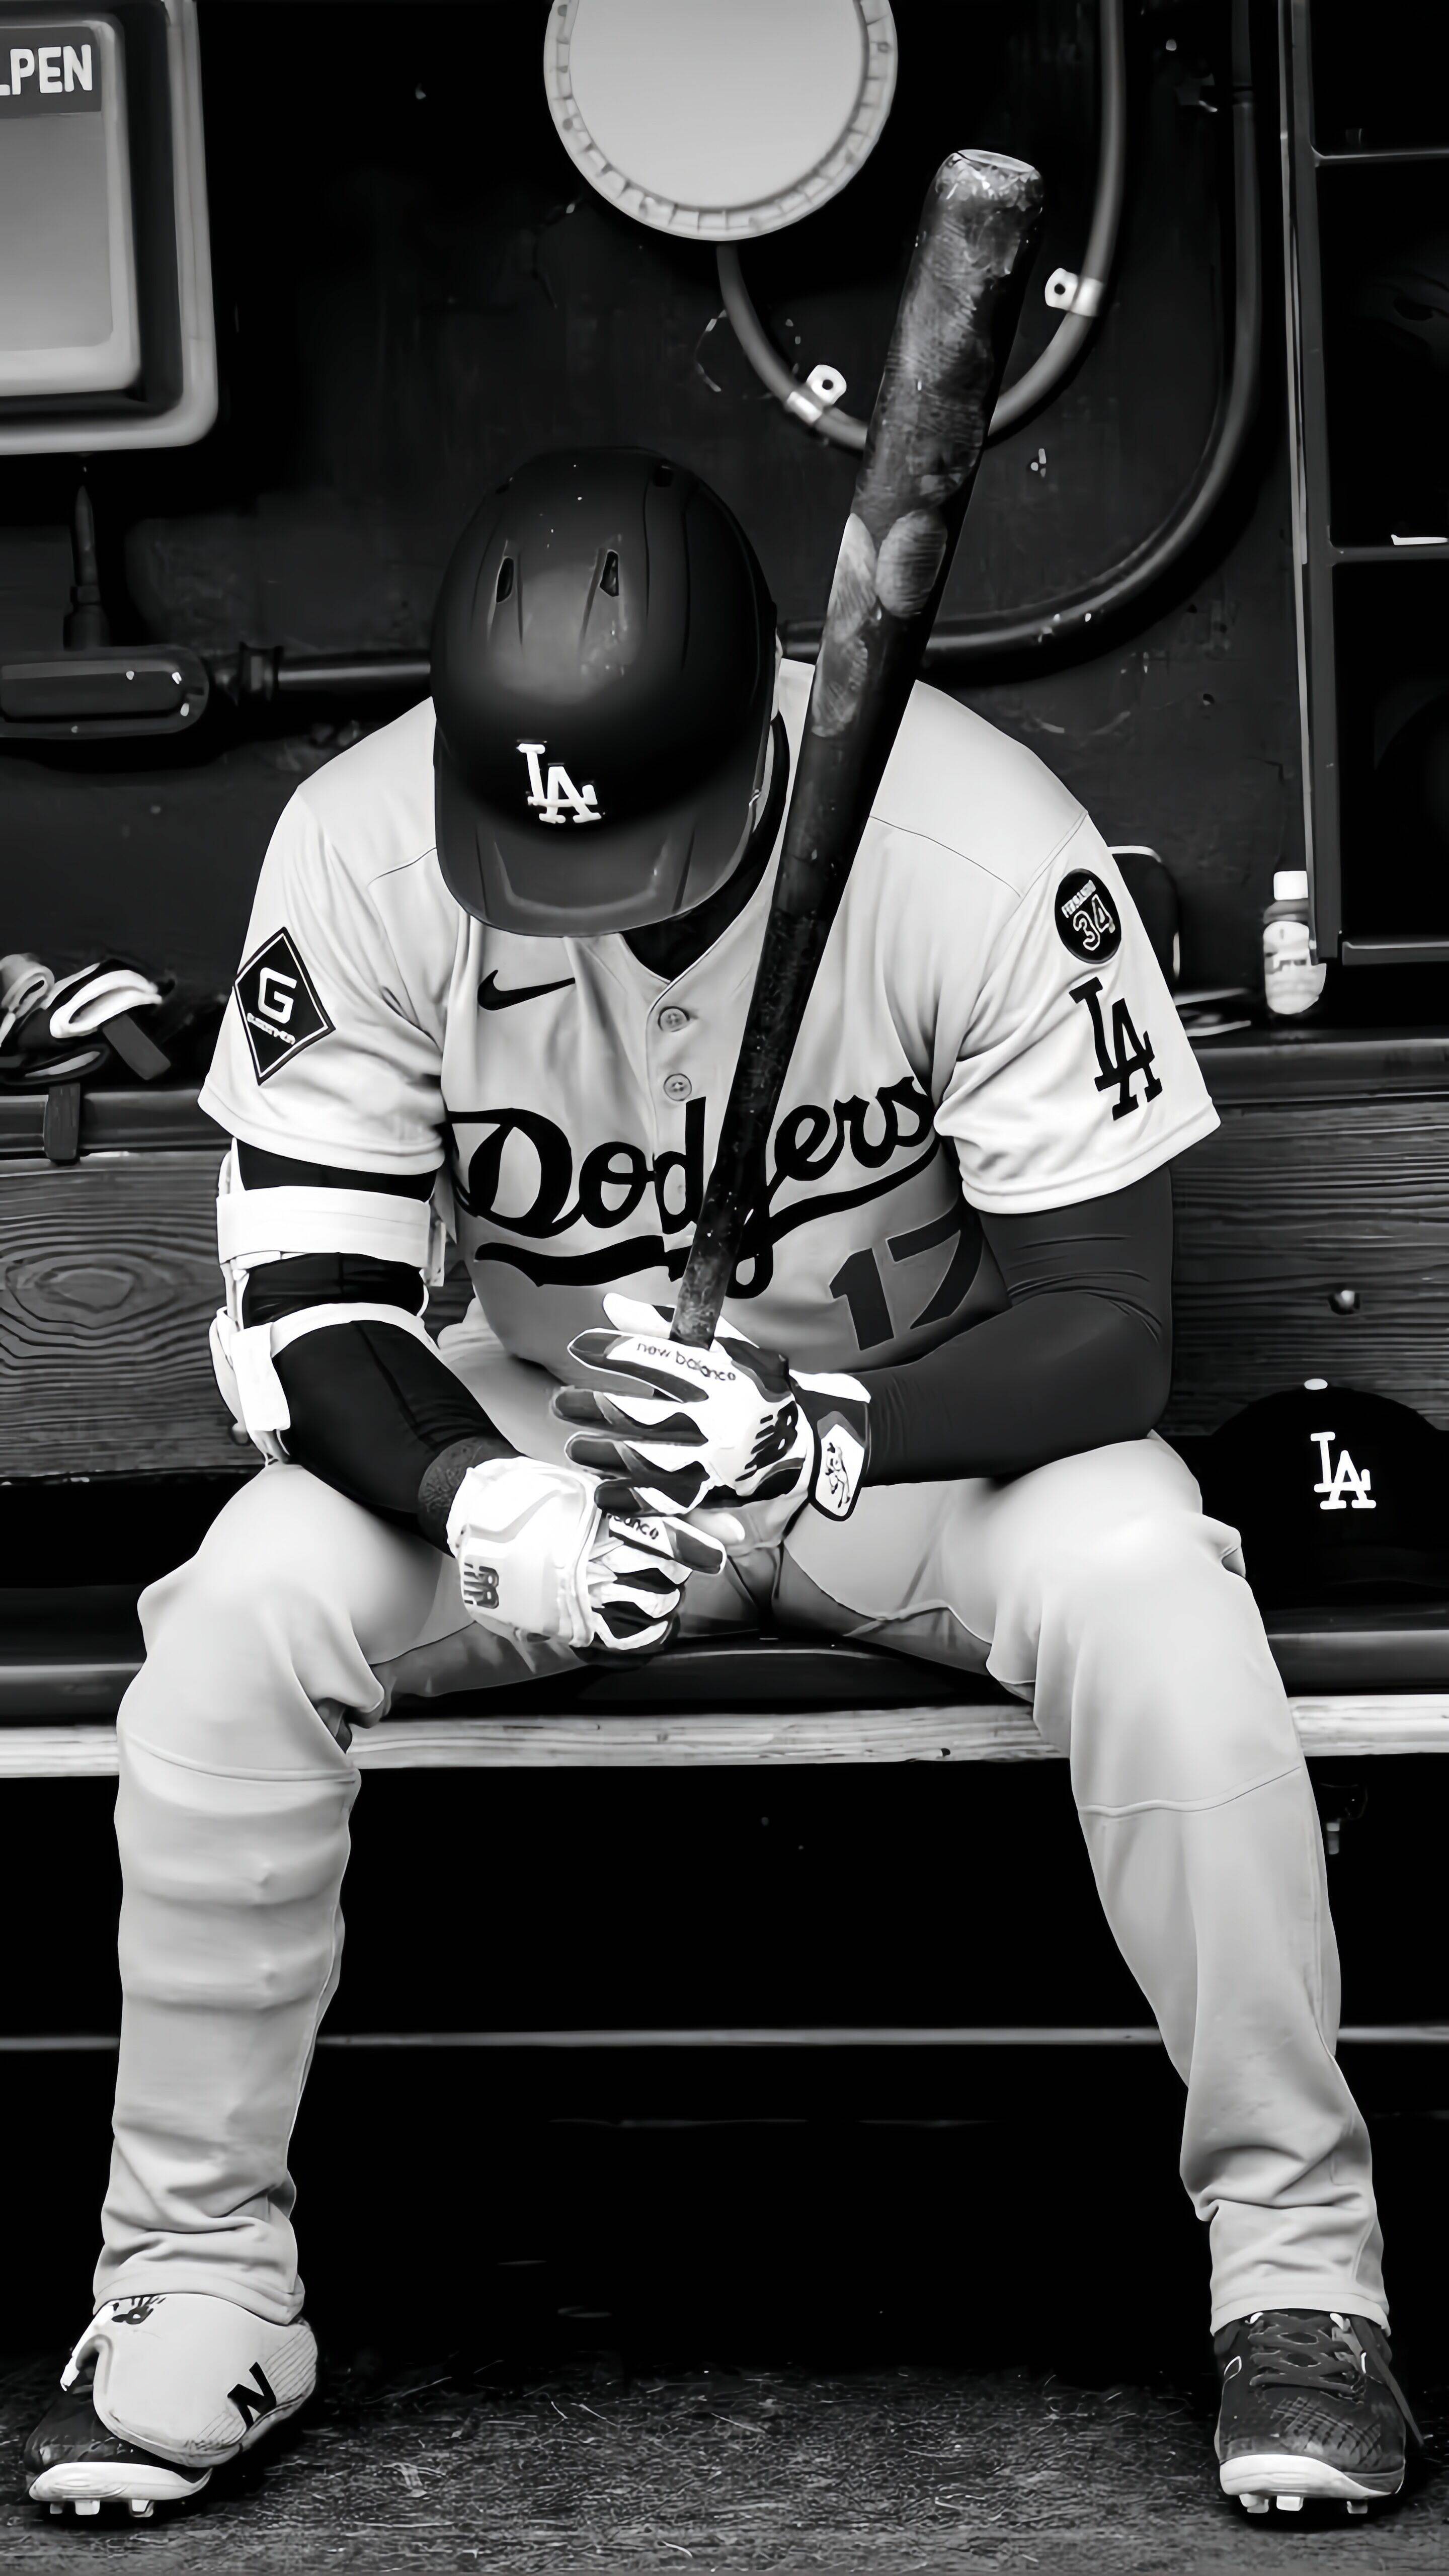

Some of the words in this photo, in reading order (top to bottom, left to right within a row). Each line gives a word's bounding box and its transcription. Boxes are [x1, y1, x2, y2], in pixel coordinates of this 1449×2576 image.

[516, 743, 602, 824] LA
[1073, 894, 1115, 950] 34
[258, 967, 297, 1024] G
[1069, 976, 1163, 1120] LA
[829, 1200, 982, 1351] 17
[1310, 1431, 1377, 1510] LA
